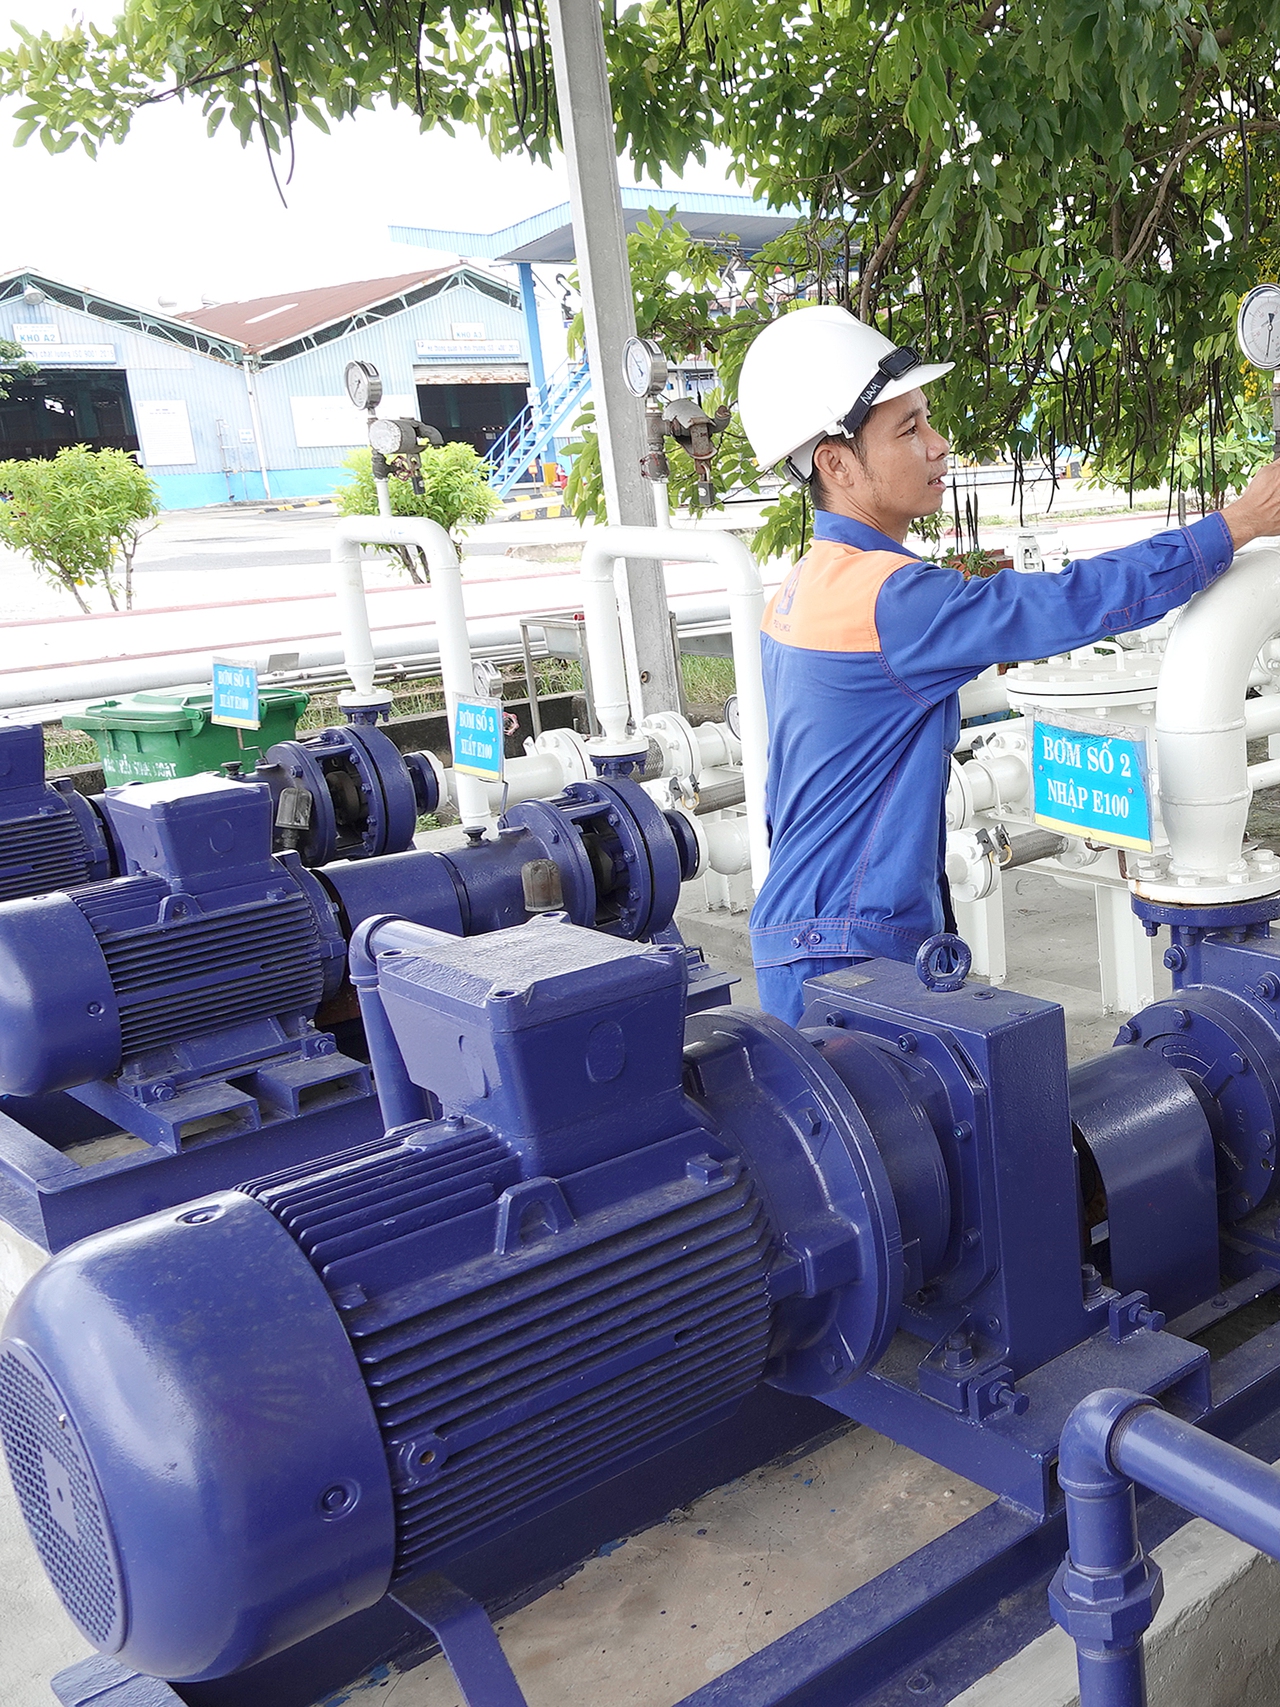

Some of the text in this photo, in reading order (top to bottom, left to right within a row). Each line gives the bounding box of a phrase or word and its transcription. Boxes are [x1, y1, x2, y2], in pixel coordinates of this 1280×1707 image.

[19, 333, 56, 342] KHO A2
[860, 382, 881, 405] NAM
[218, 668, 251, 688] BƠM SỐ 4
[234, 695, 249, 710] E100
[459, 708, 495, 733] BƠM SỐ 3
[477, 742, 493, 759] E100
[1042, 735, 1132, 778] BƠM SỐ 2
[1046, 777, 1130, 819] NHẬP E100
